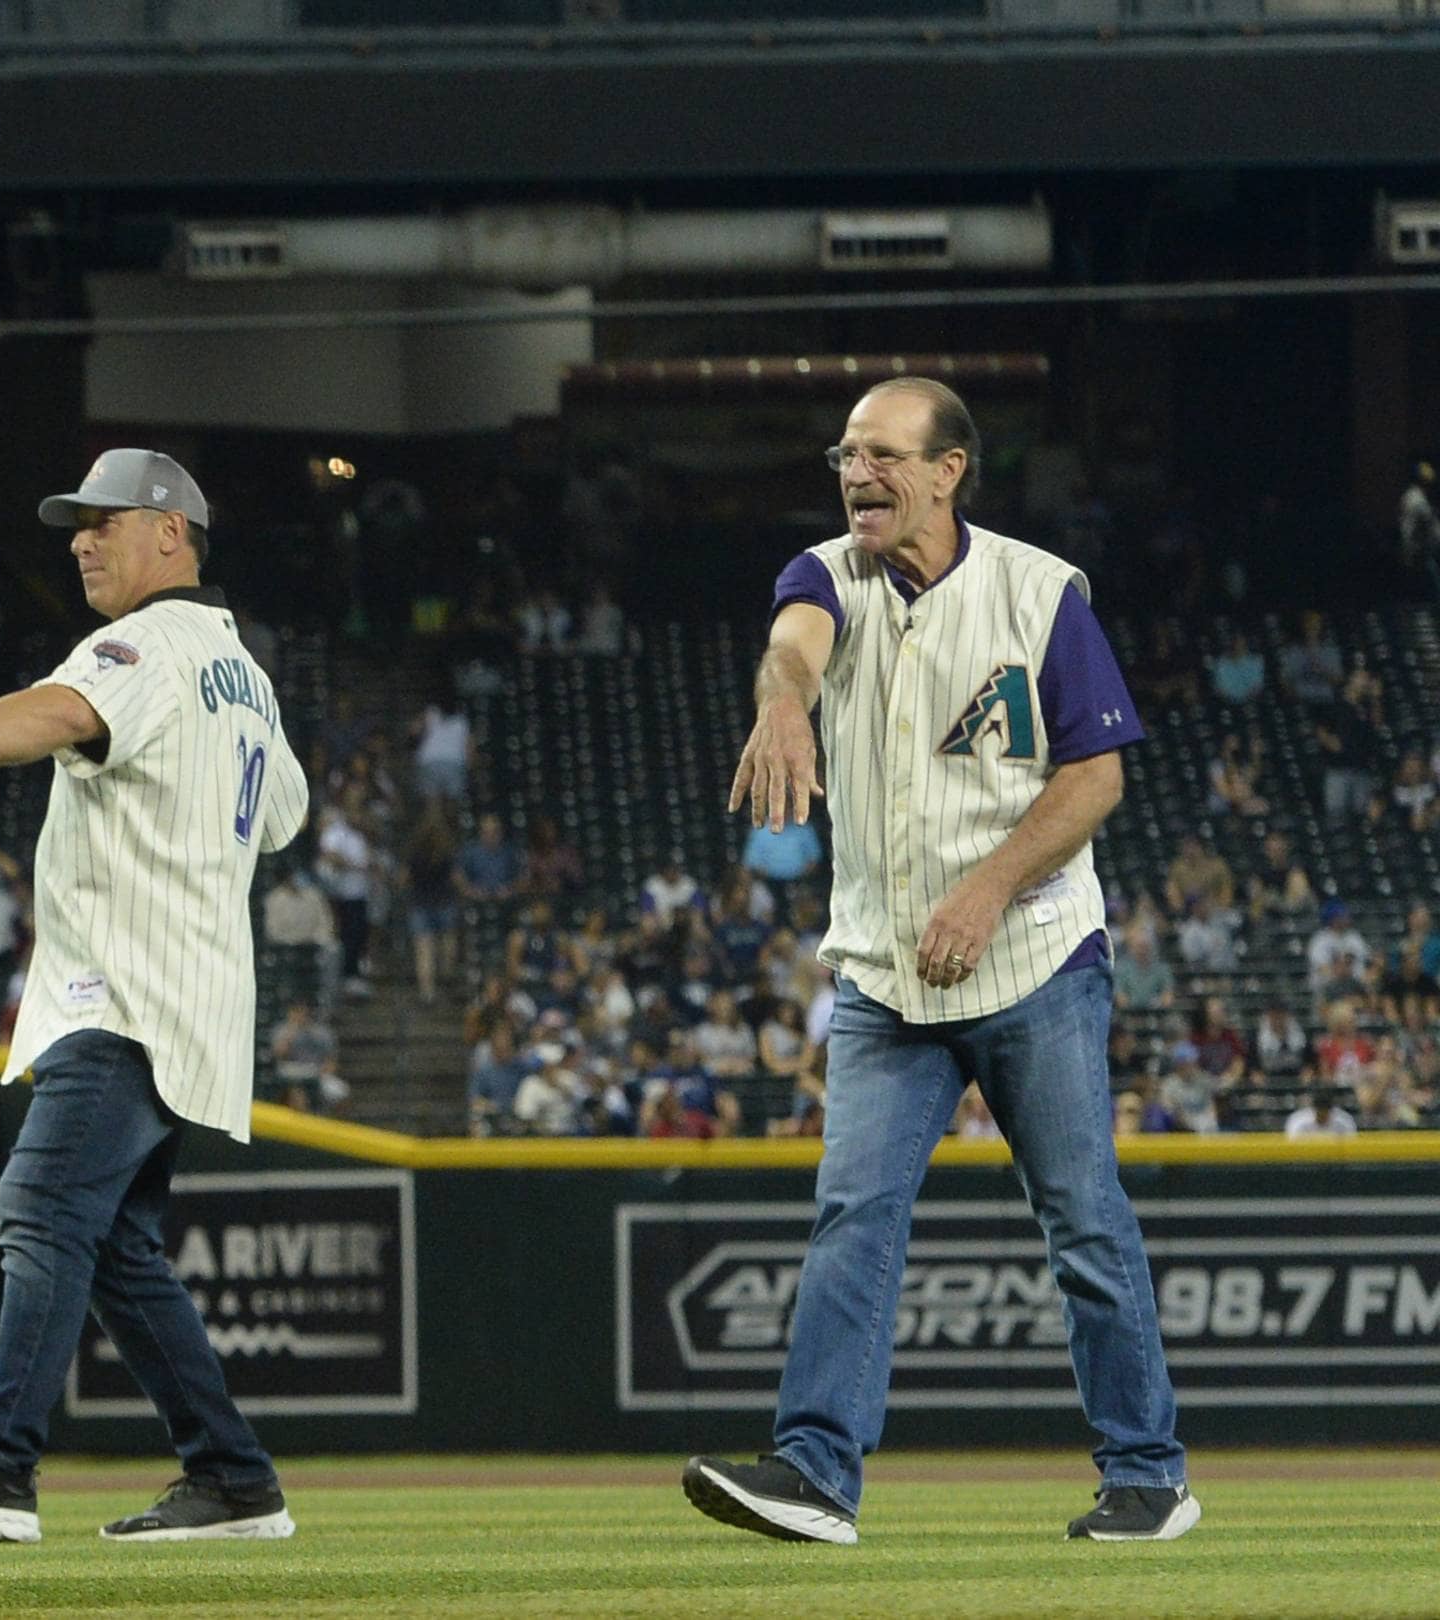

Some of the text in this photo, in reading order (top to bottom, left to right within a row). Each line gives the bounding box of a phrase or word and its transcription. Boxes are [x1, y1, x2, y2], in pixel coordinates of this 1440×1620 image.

[222, 1223, 381, 1280] RIVER
[1160, 1264, 1440, 1338] 98.7 FM
